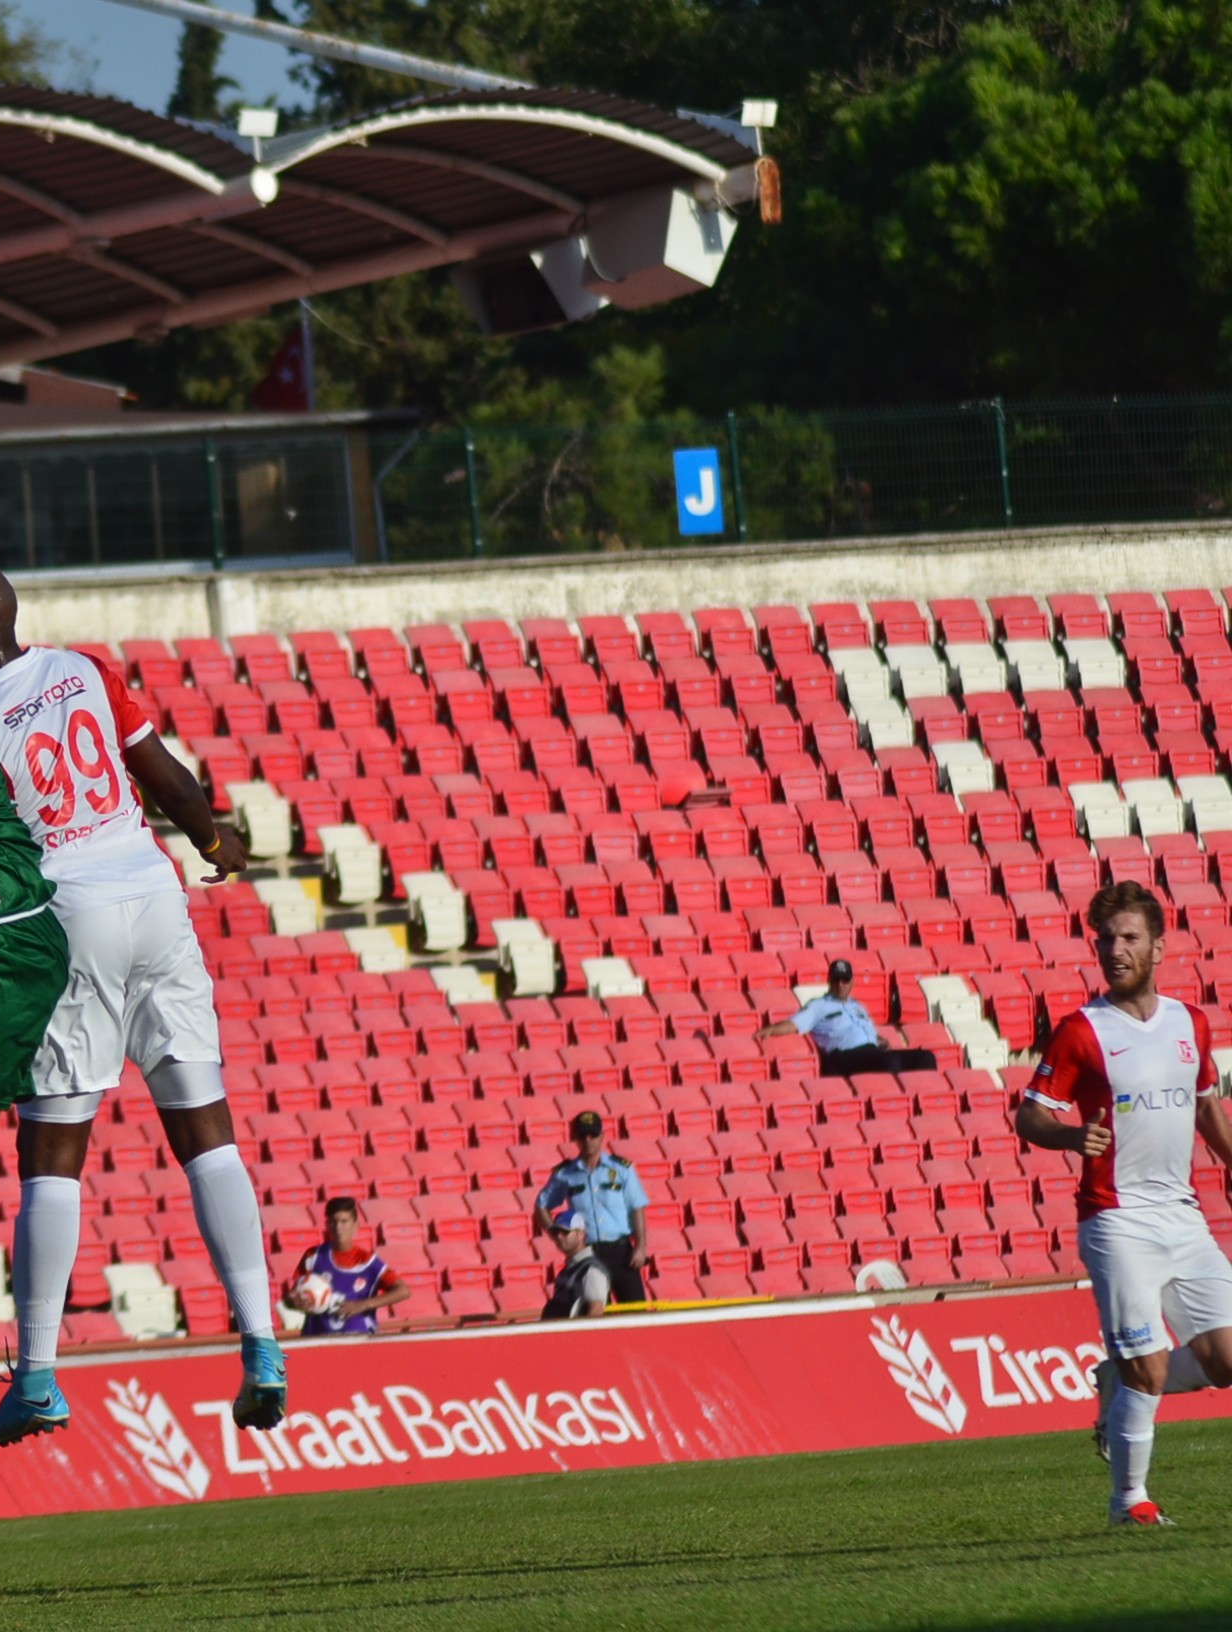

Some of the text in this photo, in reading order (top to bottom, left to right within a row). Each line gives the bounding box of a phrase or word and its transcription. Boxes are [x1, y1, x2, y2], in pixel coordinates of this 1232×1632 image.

[684, 467, 716, 517] J
[25, 708, 122, 828] 99
[949, 1330, 1108, 1408] Ziraa
[382, 1378, 646, 1459] Bankası
